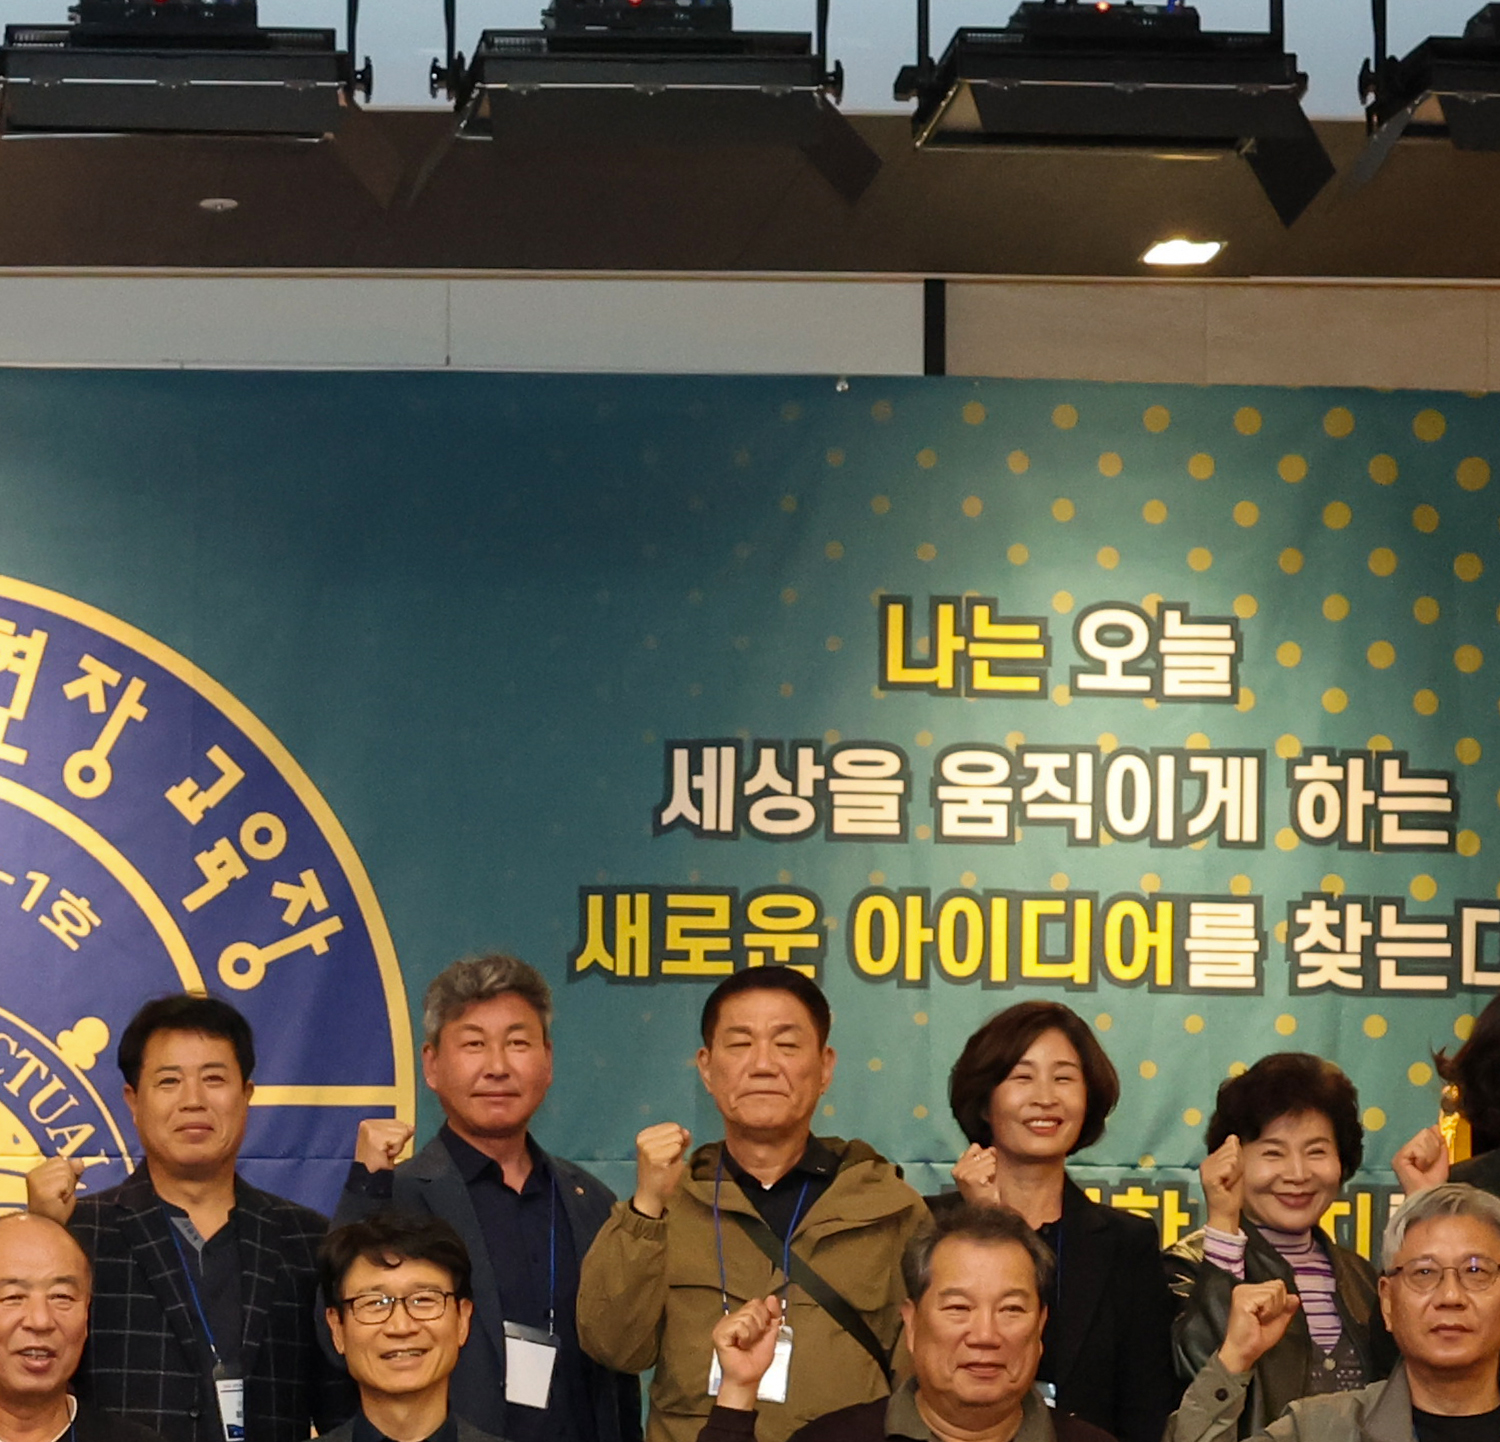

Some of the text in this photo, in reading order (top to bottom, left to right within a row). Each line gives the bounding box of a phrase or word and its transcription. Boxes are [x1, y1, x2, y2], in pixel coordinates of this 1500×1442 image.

[886, 602, 1237, 698] 나는 오늘
[660, 745, 1453, 845] 세상을 움직이게 하는
[164, 744, 345, 991] 교육장
[575, 892, 820, 980] 새로운
[853, 893, 1261, 989] 아이디어를
